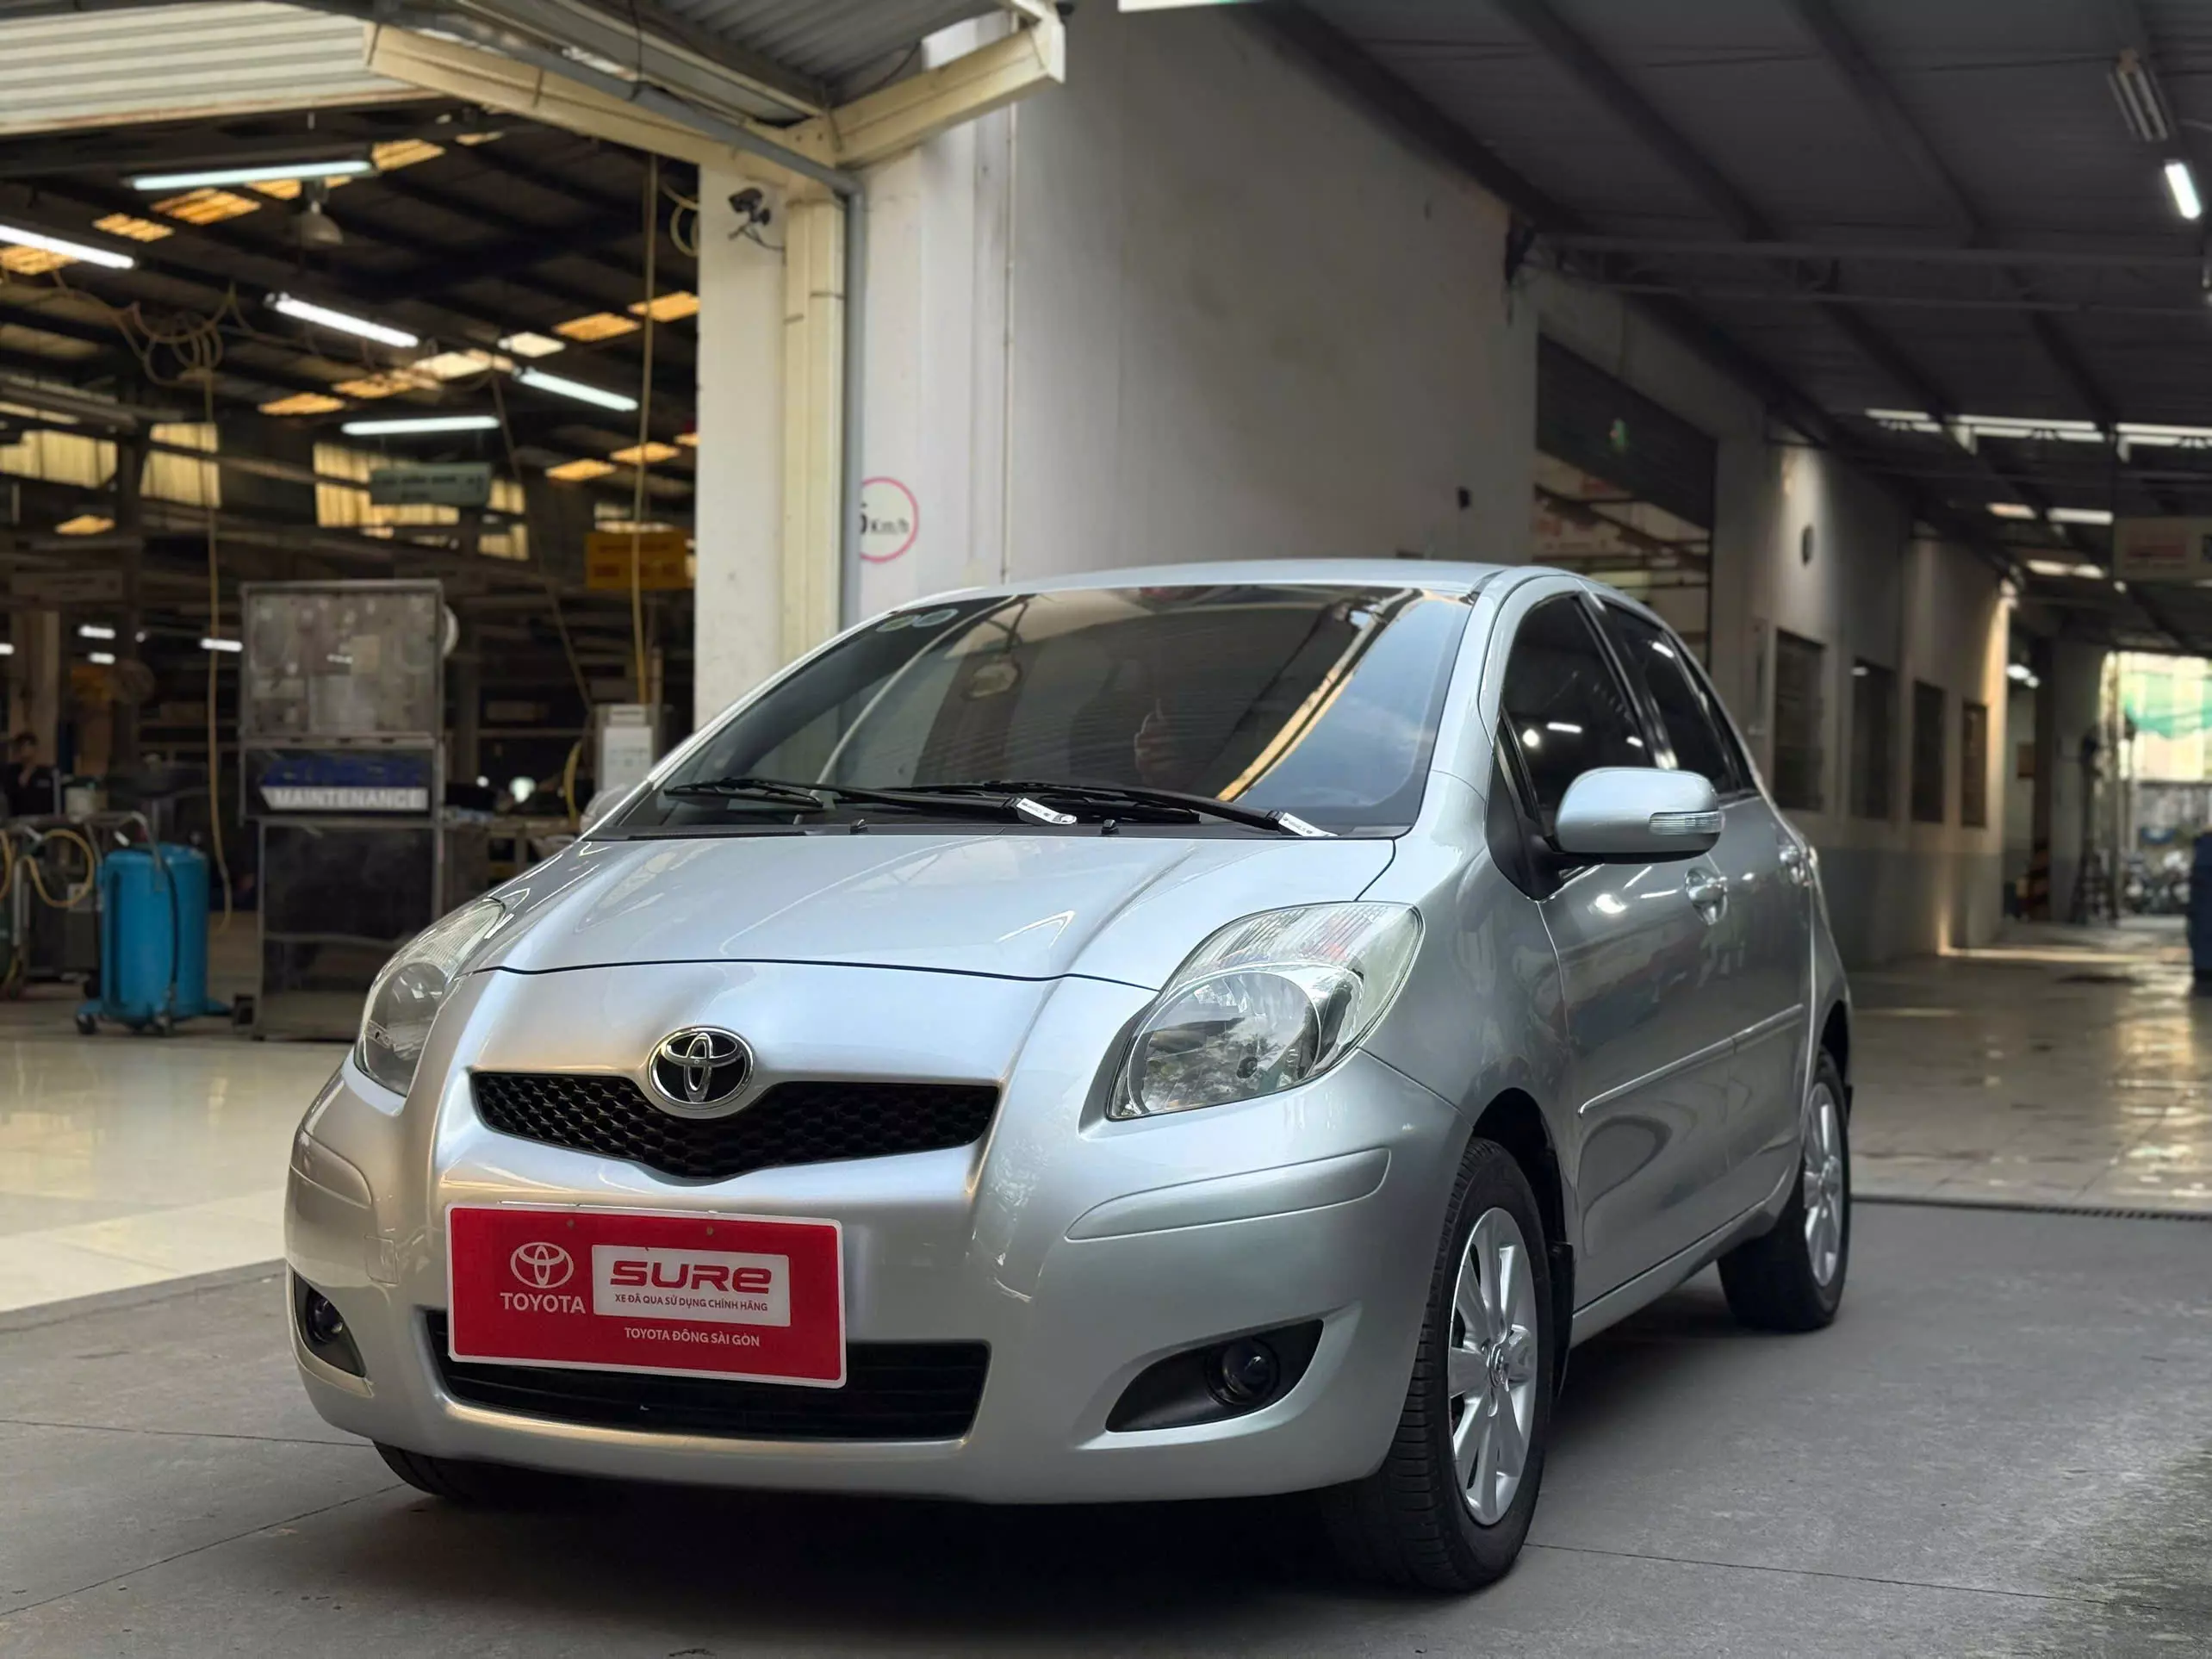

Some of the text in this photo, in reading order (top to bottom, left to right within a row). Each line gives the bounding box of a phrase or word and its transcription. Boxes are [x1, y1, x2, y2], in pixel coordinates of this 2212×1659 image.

[273, 789, 423, 808] MAINTENANCE
[500, 1292, 587, 1314] TOYOTA
[615, 1294, 626, 1302] XE
[643, 1296, 663, 1307] QUA
[679, 1297, 706, 1308] DỤNG
[708, 1299, 738, 1309] CHÍNH
[624, 1327, 760, 1346] TOYOTA ĐÔNG SÀI GÒN
